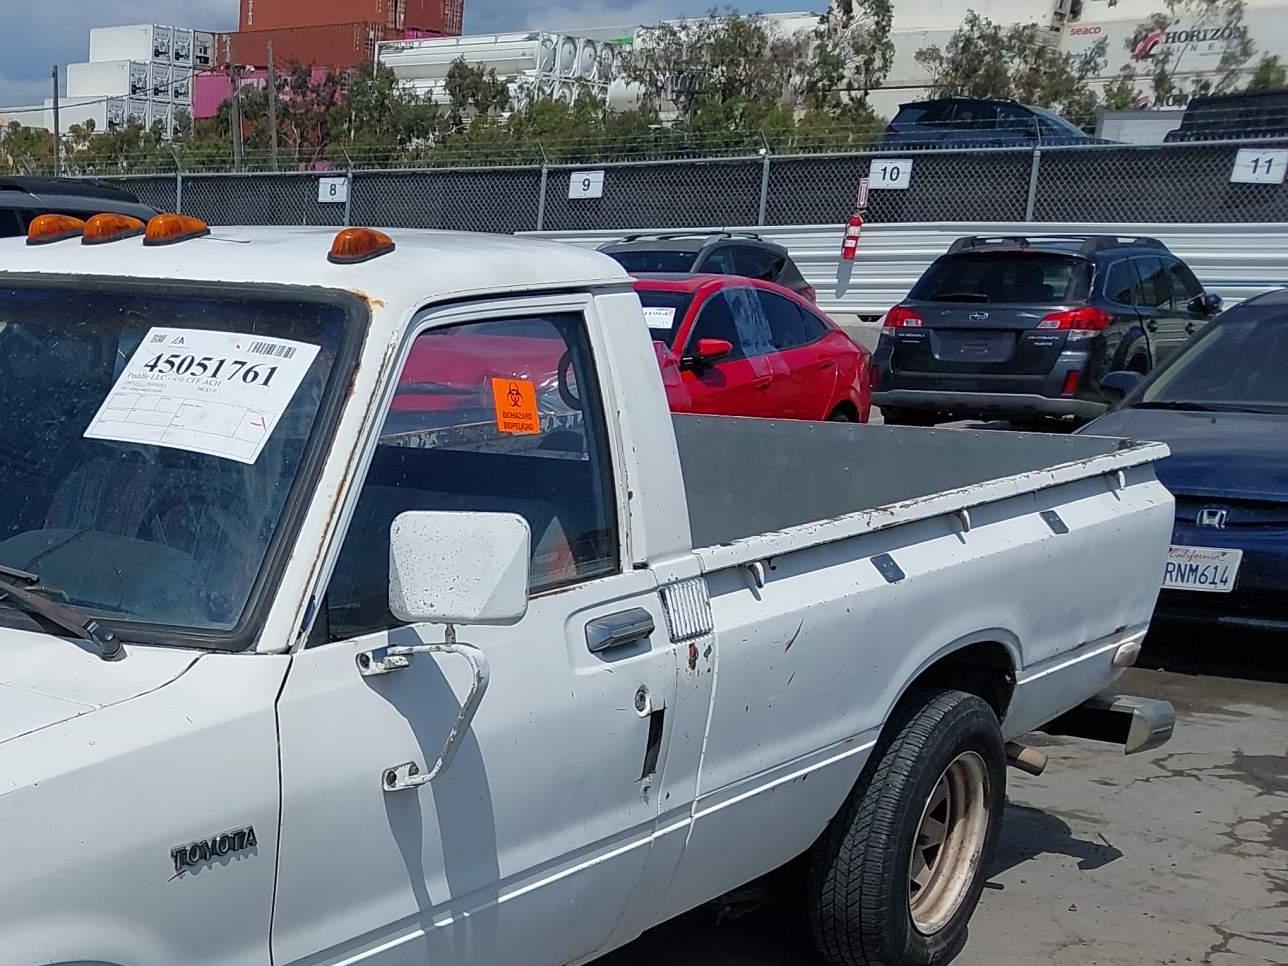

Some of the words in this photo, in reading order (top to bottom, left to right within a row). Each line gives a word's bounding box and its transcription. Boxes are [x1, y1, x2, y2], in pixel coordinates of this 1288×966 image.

[1070, 25, 1102, 36] seaco
[1250, 157, 1274, 174] 11
[880, 166, 900, 182] 10
[329, 183, 337, 196] 8
[582, 178, 591, 192] 9
[144, 352, 279, 388] 45051761
[1169, 548, 1224, 562] California
[1162, 562, 1229, 586] RNM614
[171, 825, 258, 872] TOYOTA
